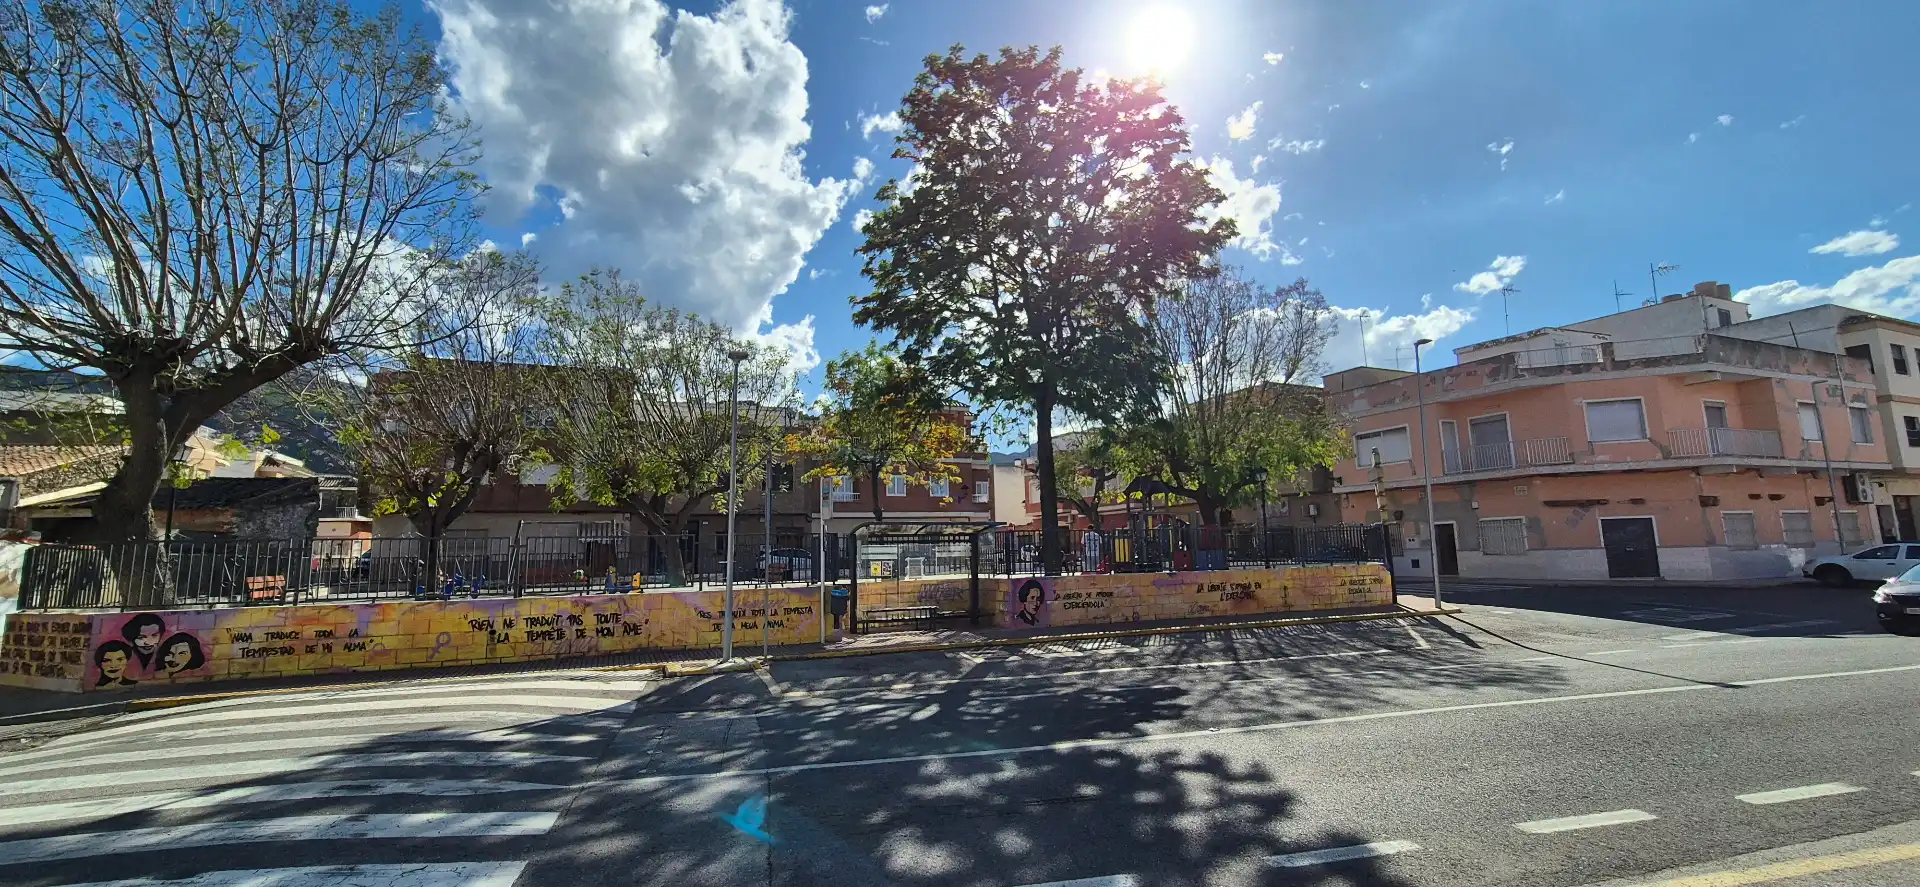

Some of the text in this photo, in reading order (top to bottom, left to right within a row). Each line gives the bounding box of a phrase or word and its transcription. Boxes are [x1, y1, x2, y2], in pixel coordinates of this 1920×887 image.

[503, 617, 516, 629] NE
[567, 614, 583, 626] PAS
[594, 613, 622, 625] TOUTE
[313, 629, 333, 638] TODA
[348, 628, 359, 638] LA
[497, 632, 509, 643] LA
[525, 627, 566, 641] TEMPÊTE
[575, 628, 587, 639] DE
[596, 627, 614, 637] MON
[239, 646, 295, 658] TEMPESTAD
[305, 643, 318, 653] DE
